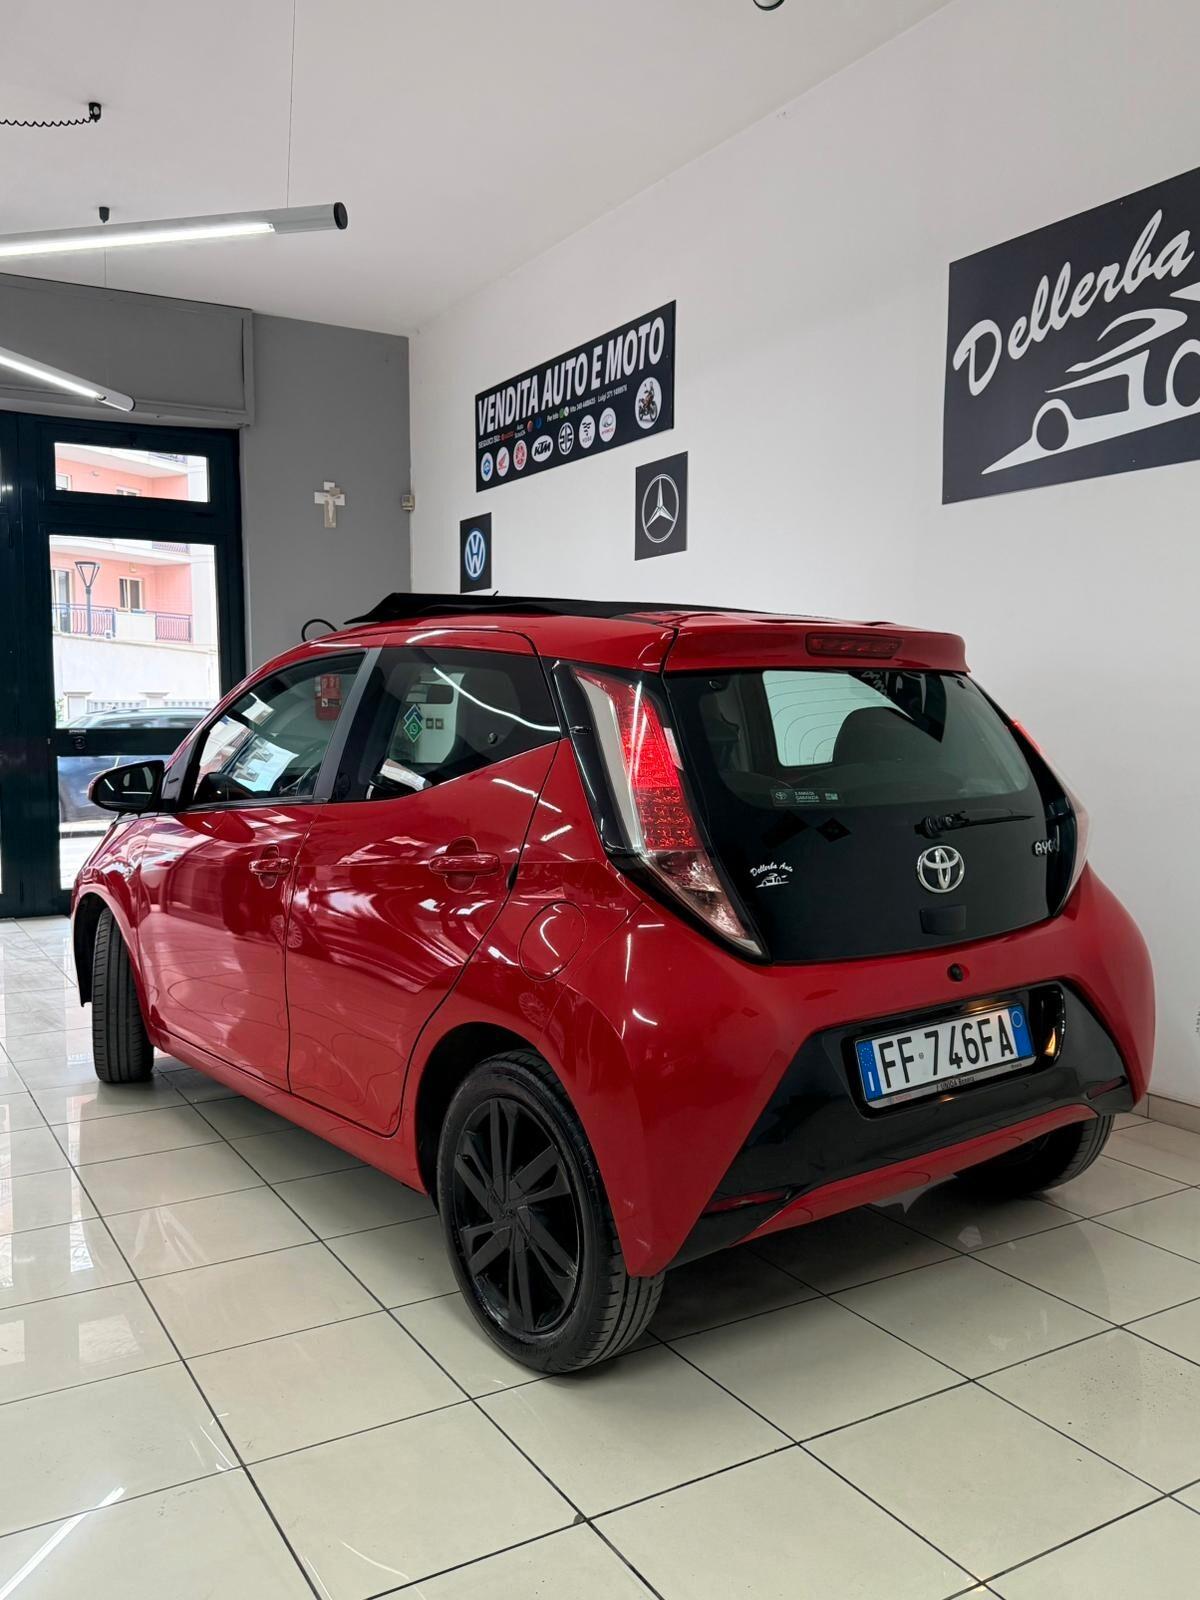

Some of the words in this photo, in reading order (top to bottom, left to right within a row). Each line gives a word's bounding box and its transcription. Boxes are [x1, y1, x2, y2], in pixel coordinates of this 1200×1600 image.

[953, 209, 1195, 396] Dellerba
[478, 374, 538, 436] VENDITA
[541, 352, 588, 411] AUTO
[591, 344, 603, 391] E
[604, 316, 665, 385] MOTO
[533, 440, 551, 457] KTM
[749, 861, 778, 877] Dellerba
[878, 1036, 914, 1089] FF
[924, 1014, 1015, 1076] 746FA
